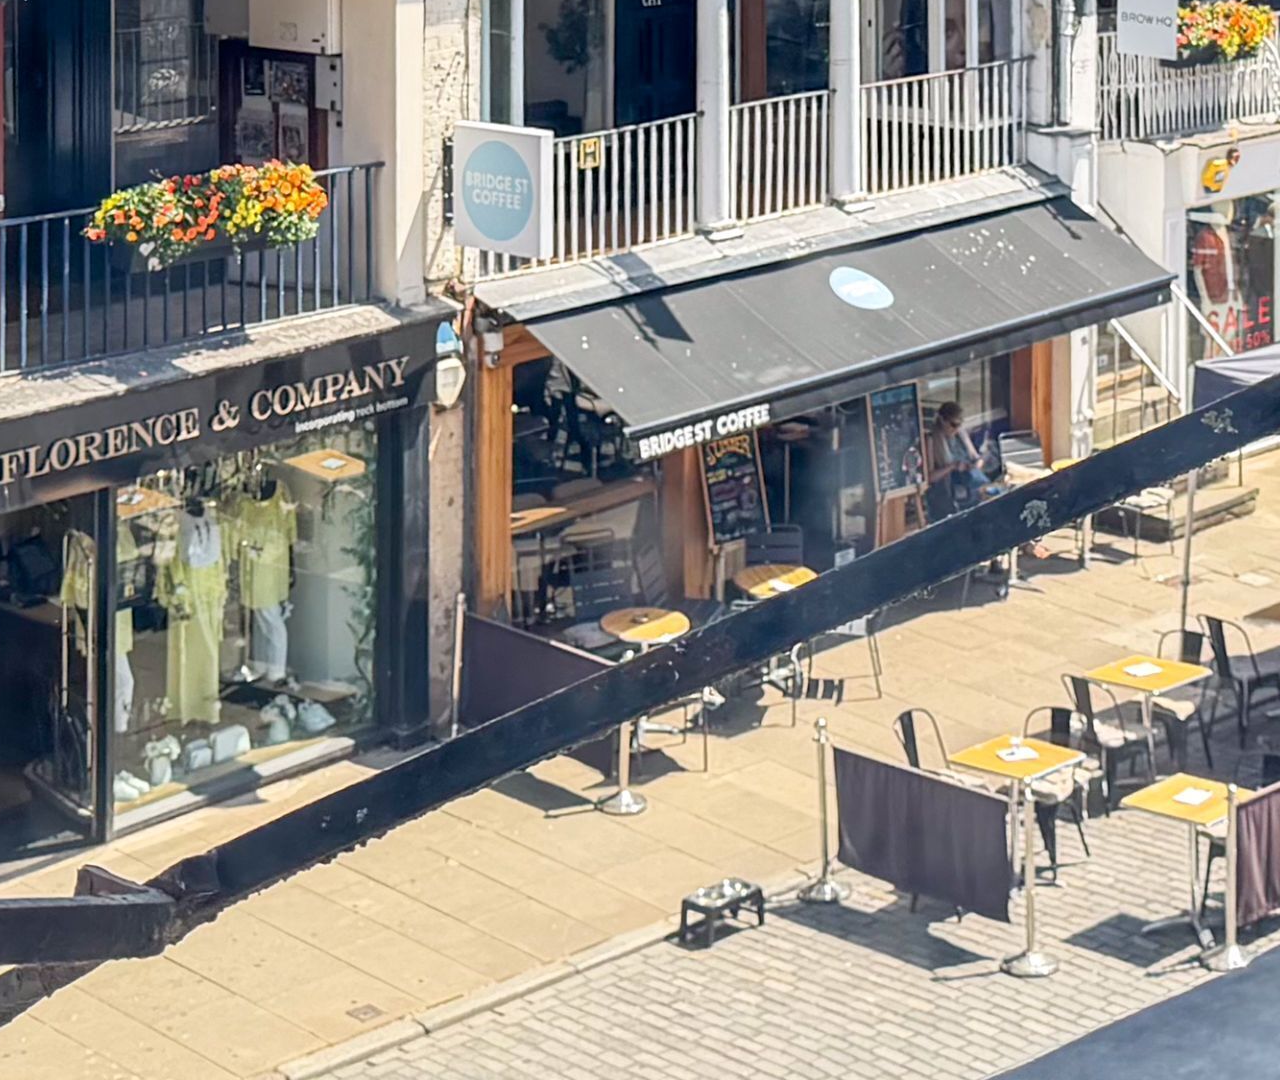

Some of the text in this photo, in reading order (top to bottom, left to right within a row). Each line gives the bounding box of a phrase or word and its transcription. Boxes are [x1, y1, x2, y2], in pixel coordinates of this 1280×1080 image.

[1121, 11, 1153, 24] BROW
[464, 170, 529, 194] BRIDGE ST
[472, 188, 521, 210] COFFEE
[1207, 296, 1272, 339] SALE
[211, 398, 241, 432] &
[251, 356, 411, 421] COMPANY
[717, 403, 770, 435] COFFEE
